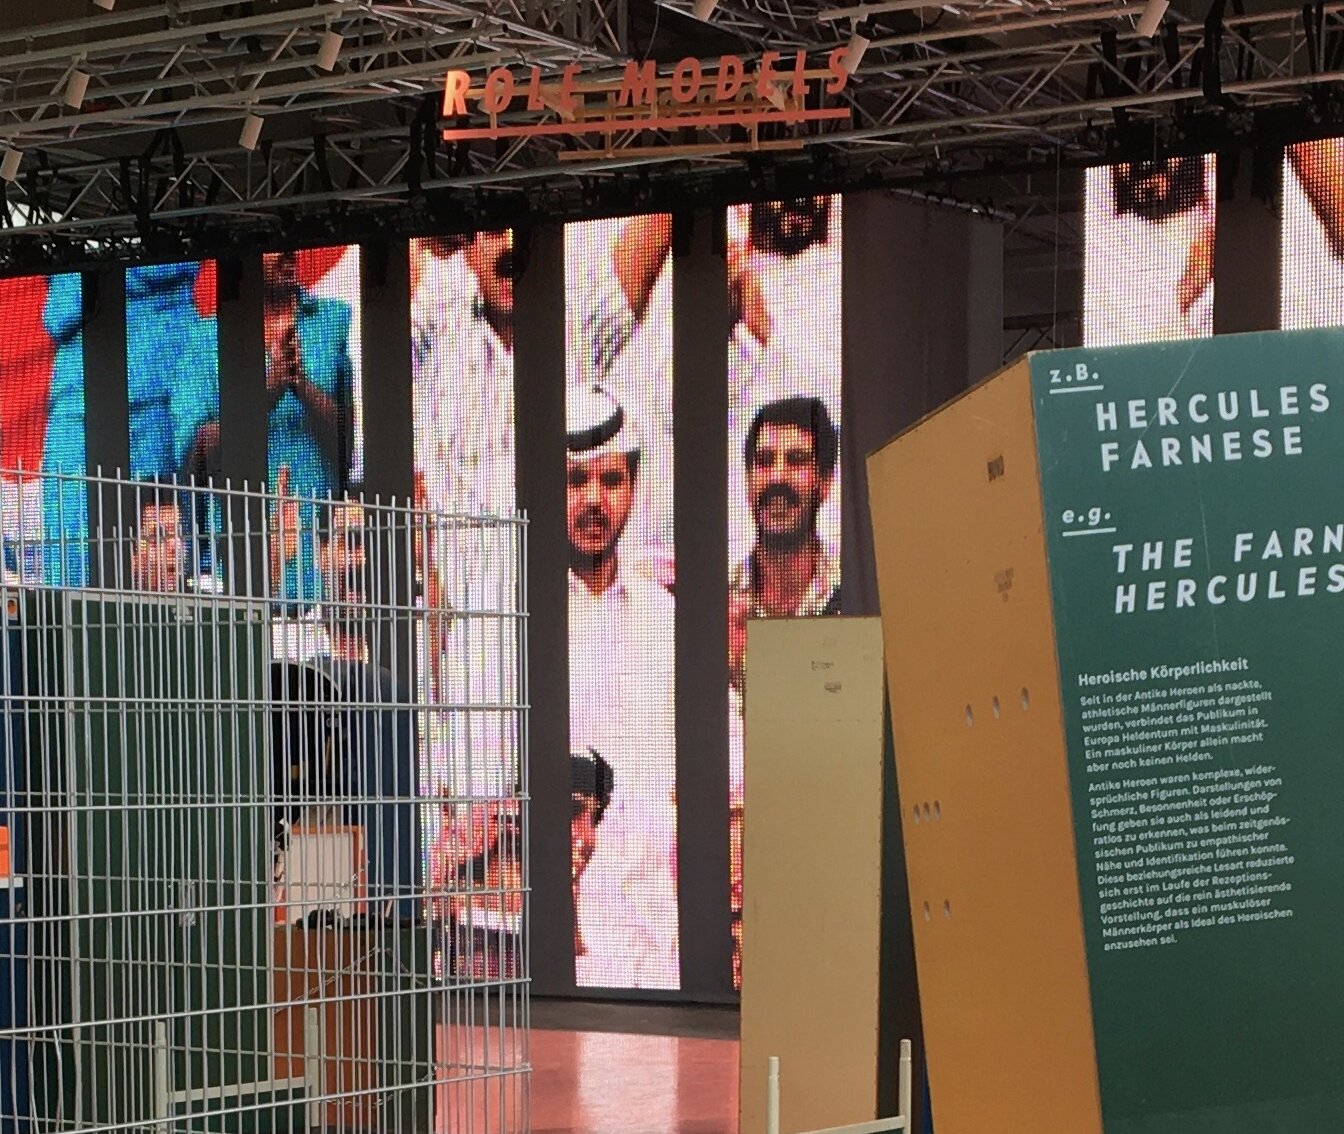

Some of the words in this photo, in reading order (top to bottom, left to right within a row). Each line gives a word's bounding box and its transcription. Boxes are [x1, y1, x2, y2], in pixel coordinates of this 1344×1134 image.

[443, 63, 584, 116] ROLE
[619, 46, 851, 106] MODELS
[1049, 363, 1100, 383] z.B.
[1096, 384, 1331, 431] HERCULES
[1101, 426, 1304, 472] FARNESE
[1062, 508, 1112, 526] e.g.
[1113, 538, 1194, 573] THE
[1078, 668, 1146, 685] Heroische
[1150, 658, 1248, 679] Körperlichkeit
[1080, 695, 1100, 705] Seit
[1103, 693, 1112, 702] in
[1115, 692, 1132, 701] der
[1134, 689, 1166, 699] Antike
[1169, 686, 1204, 695] Heroen
[1207, 683, 1222, 692] als
[1081, 705, 1138, 719] athletische
[1141, 699, 1215, 712] Männerfiguren
[1218, 691, 1271, 705] dargestellt
[1125, 715, 1173, 727] verbindet
[1176, 713, 1194, 722] das
[1197, 709, 1245, 720] Publikum
[1248, 706, 1258, 714] in
[1084, 735, 1119, 745] Europa
[1122, 729, 1177, 741] Heldentum
[1180, 725, 1198, 735] mit
[1085, 749, 1101, 758] Ein
[1104, 744, 1161, 756] maskuliner
[1164, 740, 1197, 750] Körper
[1200, 736, 1227, 746] allein
[1230, 732, 1263, 743] macht
[1086, 763, 1108, 772] aber
[1112, 759, 1136, 769] noch
[1139, 756, 1173, 766] keinen
[1088, 781, 1120, 791] Antike
[1122, 777, 1157, 787] Heroen
[1160, 774, 1189, 783] waren
[1090, 791, 1147, 806] sprüchliche
[1192, 780, 1261, 794] Darstellungen
[1263, 777, 1281, 786] von
[1139, 798, 1206, 813] Besonnenheit
[1209, 796, 1231, 805] oder
[1092, 822, 1115, 831] fung
[1118, 819, 1147, 831] geben
[1150, 815, 1164, 825] sie
[1167, 813, 1191, 823] auch
[1194, 811, 1208, 820] als
[1211, 806, 1247, 818] leidend
[1250, 804, 1269, 814] und
[1093, 835, 1122, 844] ratlos
[1189, 825, 1209, 833] was
[1211, 821, 1236, 831] beim
[1094, 847, 1133, 858] sischen
[1136, 842, 1183, 853] Publikum
[1186, 840, 1197, 848] zu
[1200, 832, 1268, 846] empathischer
[1096, 861, 1121, 871] Nähe
[1124, 857, 1143, 868] und
[1146, 851, 1213, 865] Identifikation
[1215, 848, 1248, 857] führen
[1097, 874, 1123, 884] Diese
[1126, 864, 1211, 881] beziehungsreiche
[1214, 861, 1243, 871] Lesart
[1246, 856, 1294, 867] reduzierte
[1098, 887, 1120, 898] sich
[1123, 885, 1143, 894] erst
[1146, 883, 1159, 892] im
[1162, 879, 1189, 890] Laufe
[1192, 878, 1209, 887] der
[1100, 898, 1153, 913] geschichte
[1156, 894, 1172, 904] auf
[1175, 893, 1190, 902] die
[1193, 890, 1212, 900] rein
[1214, 881, 1291, 898] ästhetisierende
[1164, 907, 1189, 916] dass
[1191, 904, 1207, 913] ein
[1210, 898, 1270, 911] muskulöser
[1102, 923, 1171, 937] Männerkörper
[1174, 920, 1188, 929] als
[1191, 916, 1215, 926] Ideal
[1217, 915, 1235, 924] des
[1237, 909, 1292, 921] Heroischen
[1104, 937, 1157, 950] anzusehen
